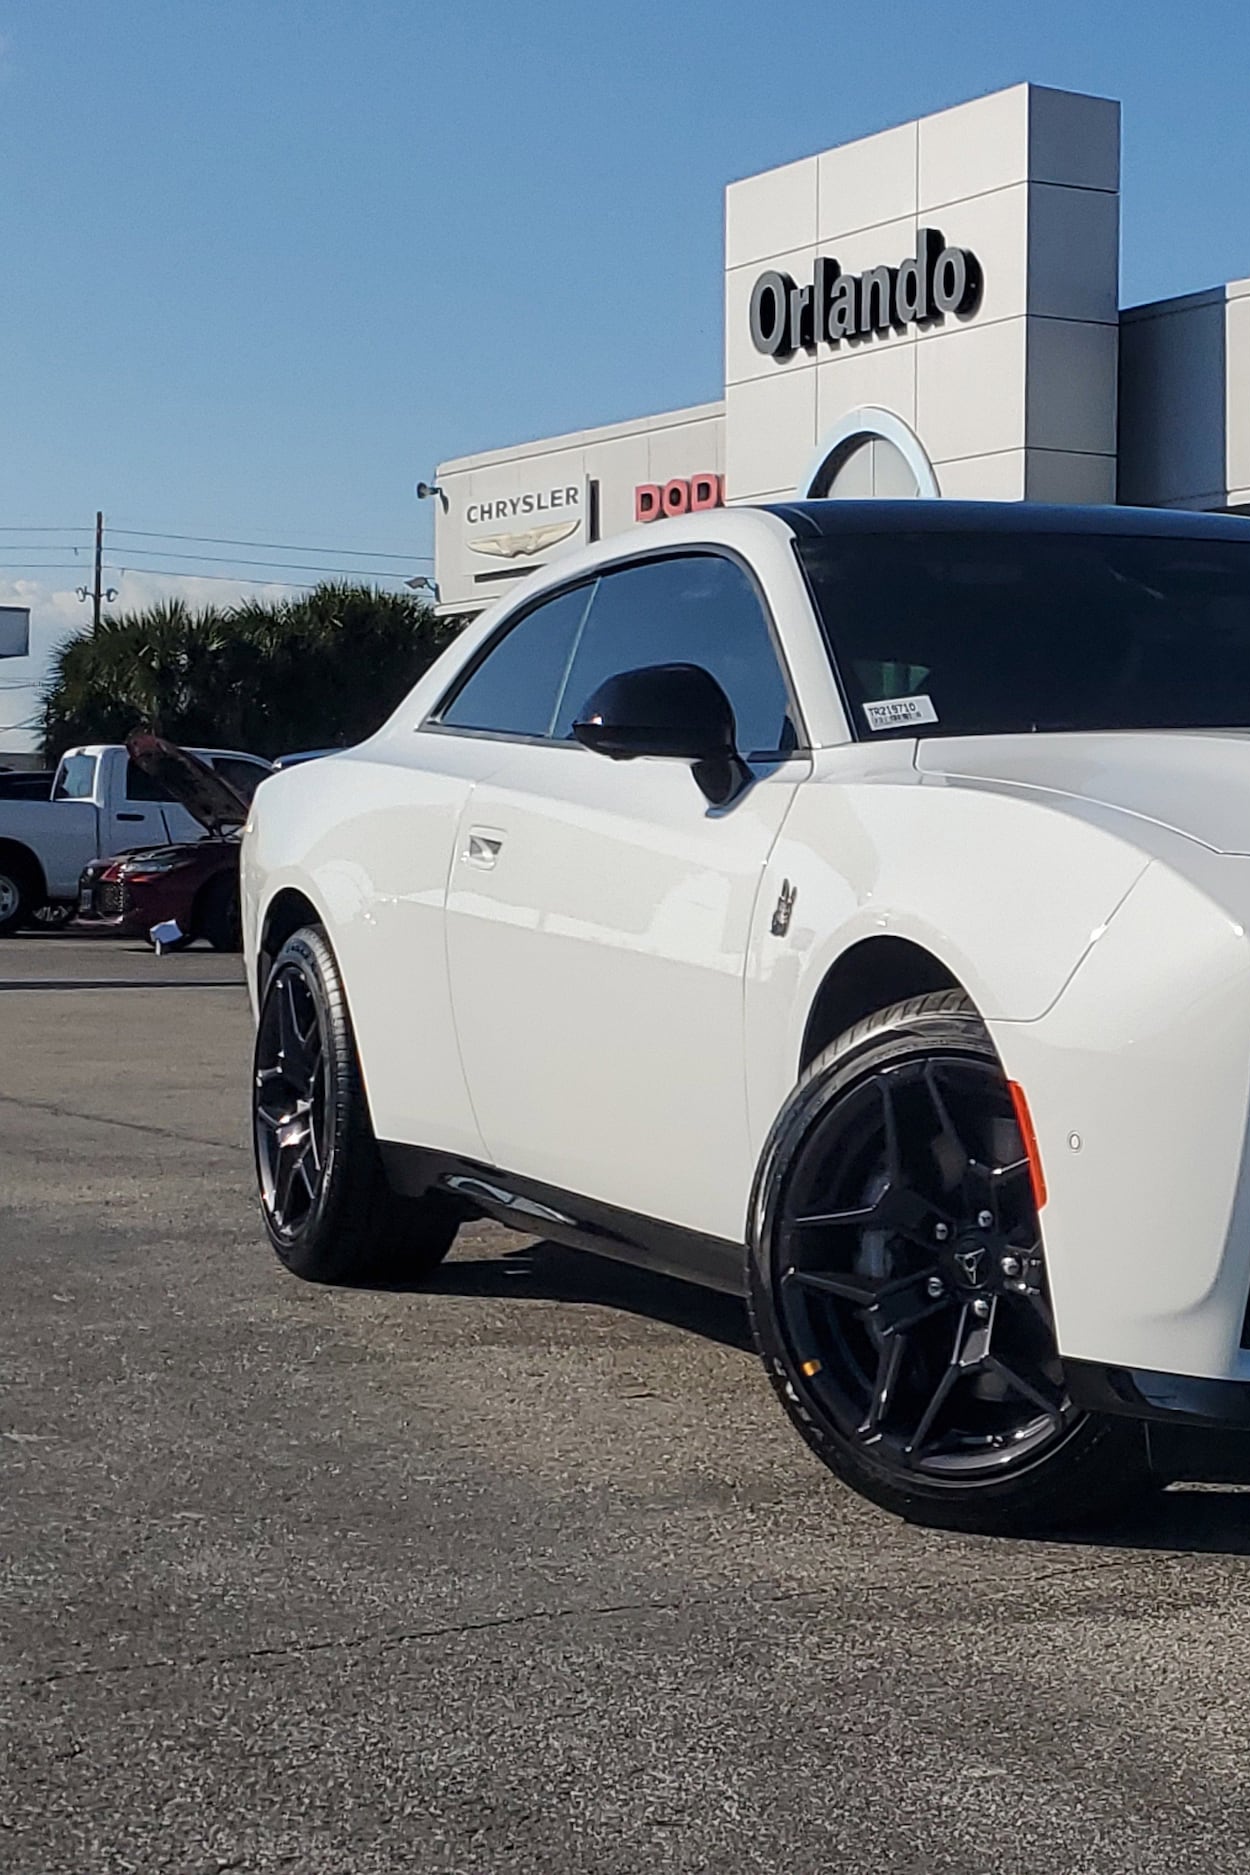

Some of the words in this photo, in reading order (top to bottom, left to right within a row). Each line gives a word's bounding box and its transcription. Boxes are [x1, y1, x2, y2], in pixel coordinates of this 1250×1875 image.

[749, 227, 982, 360] Orlando
[466, 486, 580, 524] CHRYSLER
[634, 473, 725, 523] DOD
